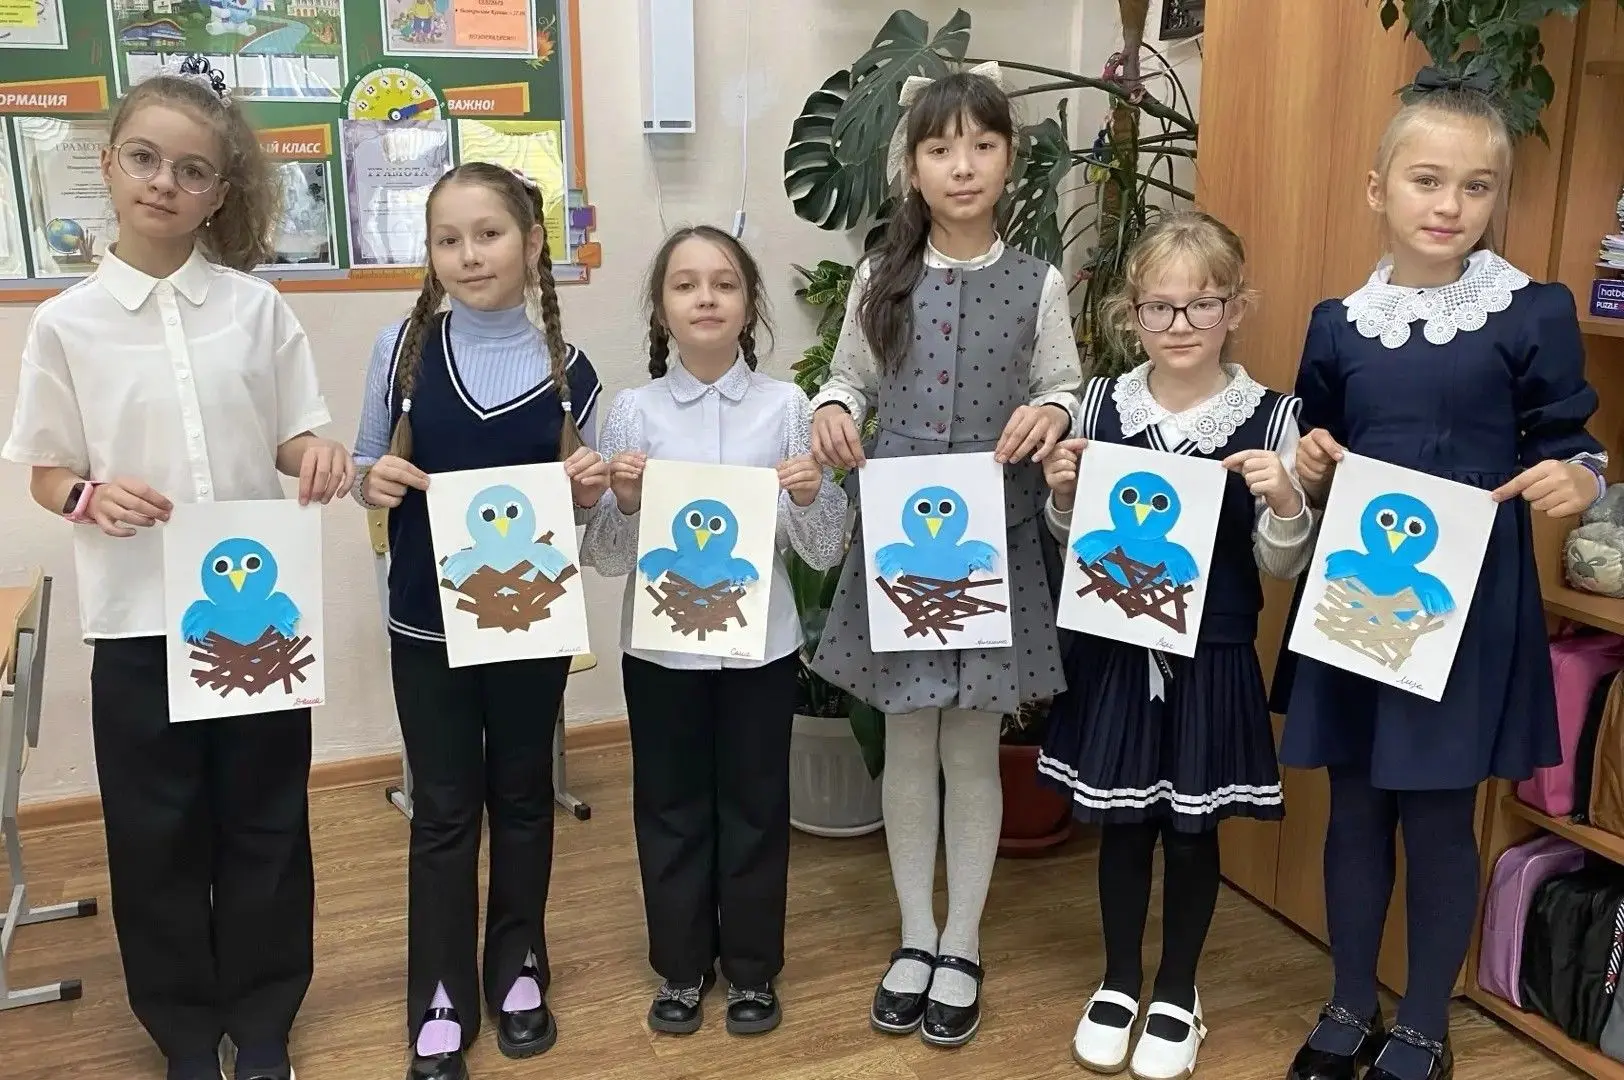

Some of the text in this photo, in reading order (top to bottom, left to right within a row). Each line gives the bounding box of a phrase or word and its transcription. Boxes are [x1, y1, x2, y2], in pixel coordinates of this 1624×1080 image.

[447, 99, 495, 111] ВАЖНО!
[282, 142, 321, 153] КЛАСС
[367, 167, 430, 177] ГРАМОТА
[1596, 301, 1619, 310] PUZZLE
